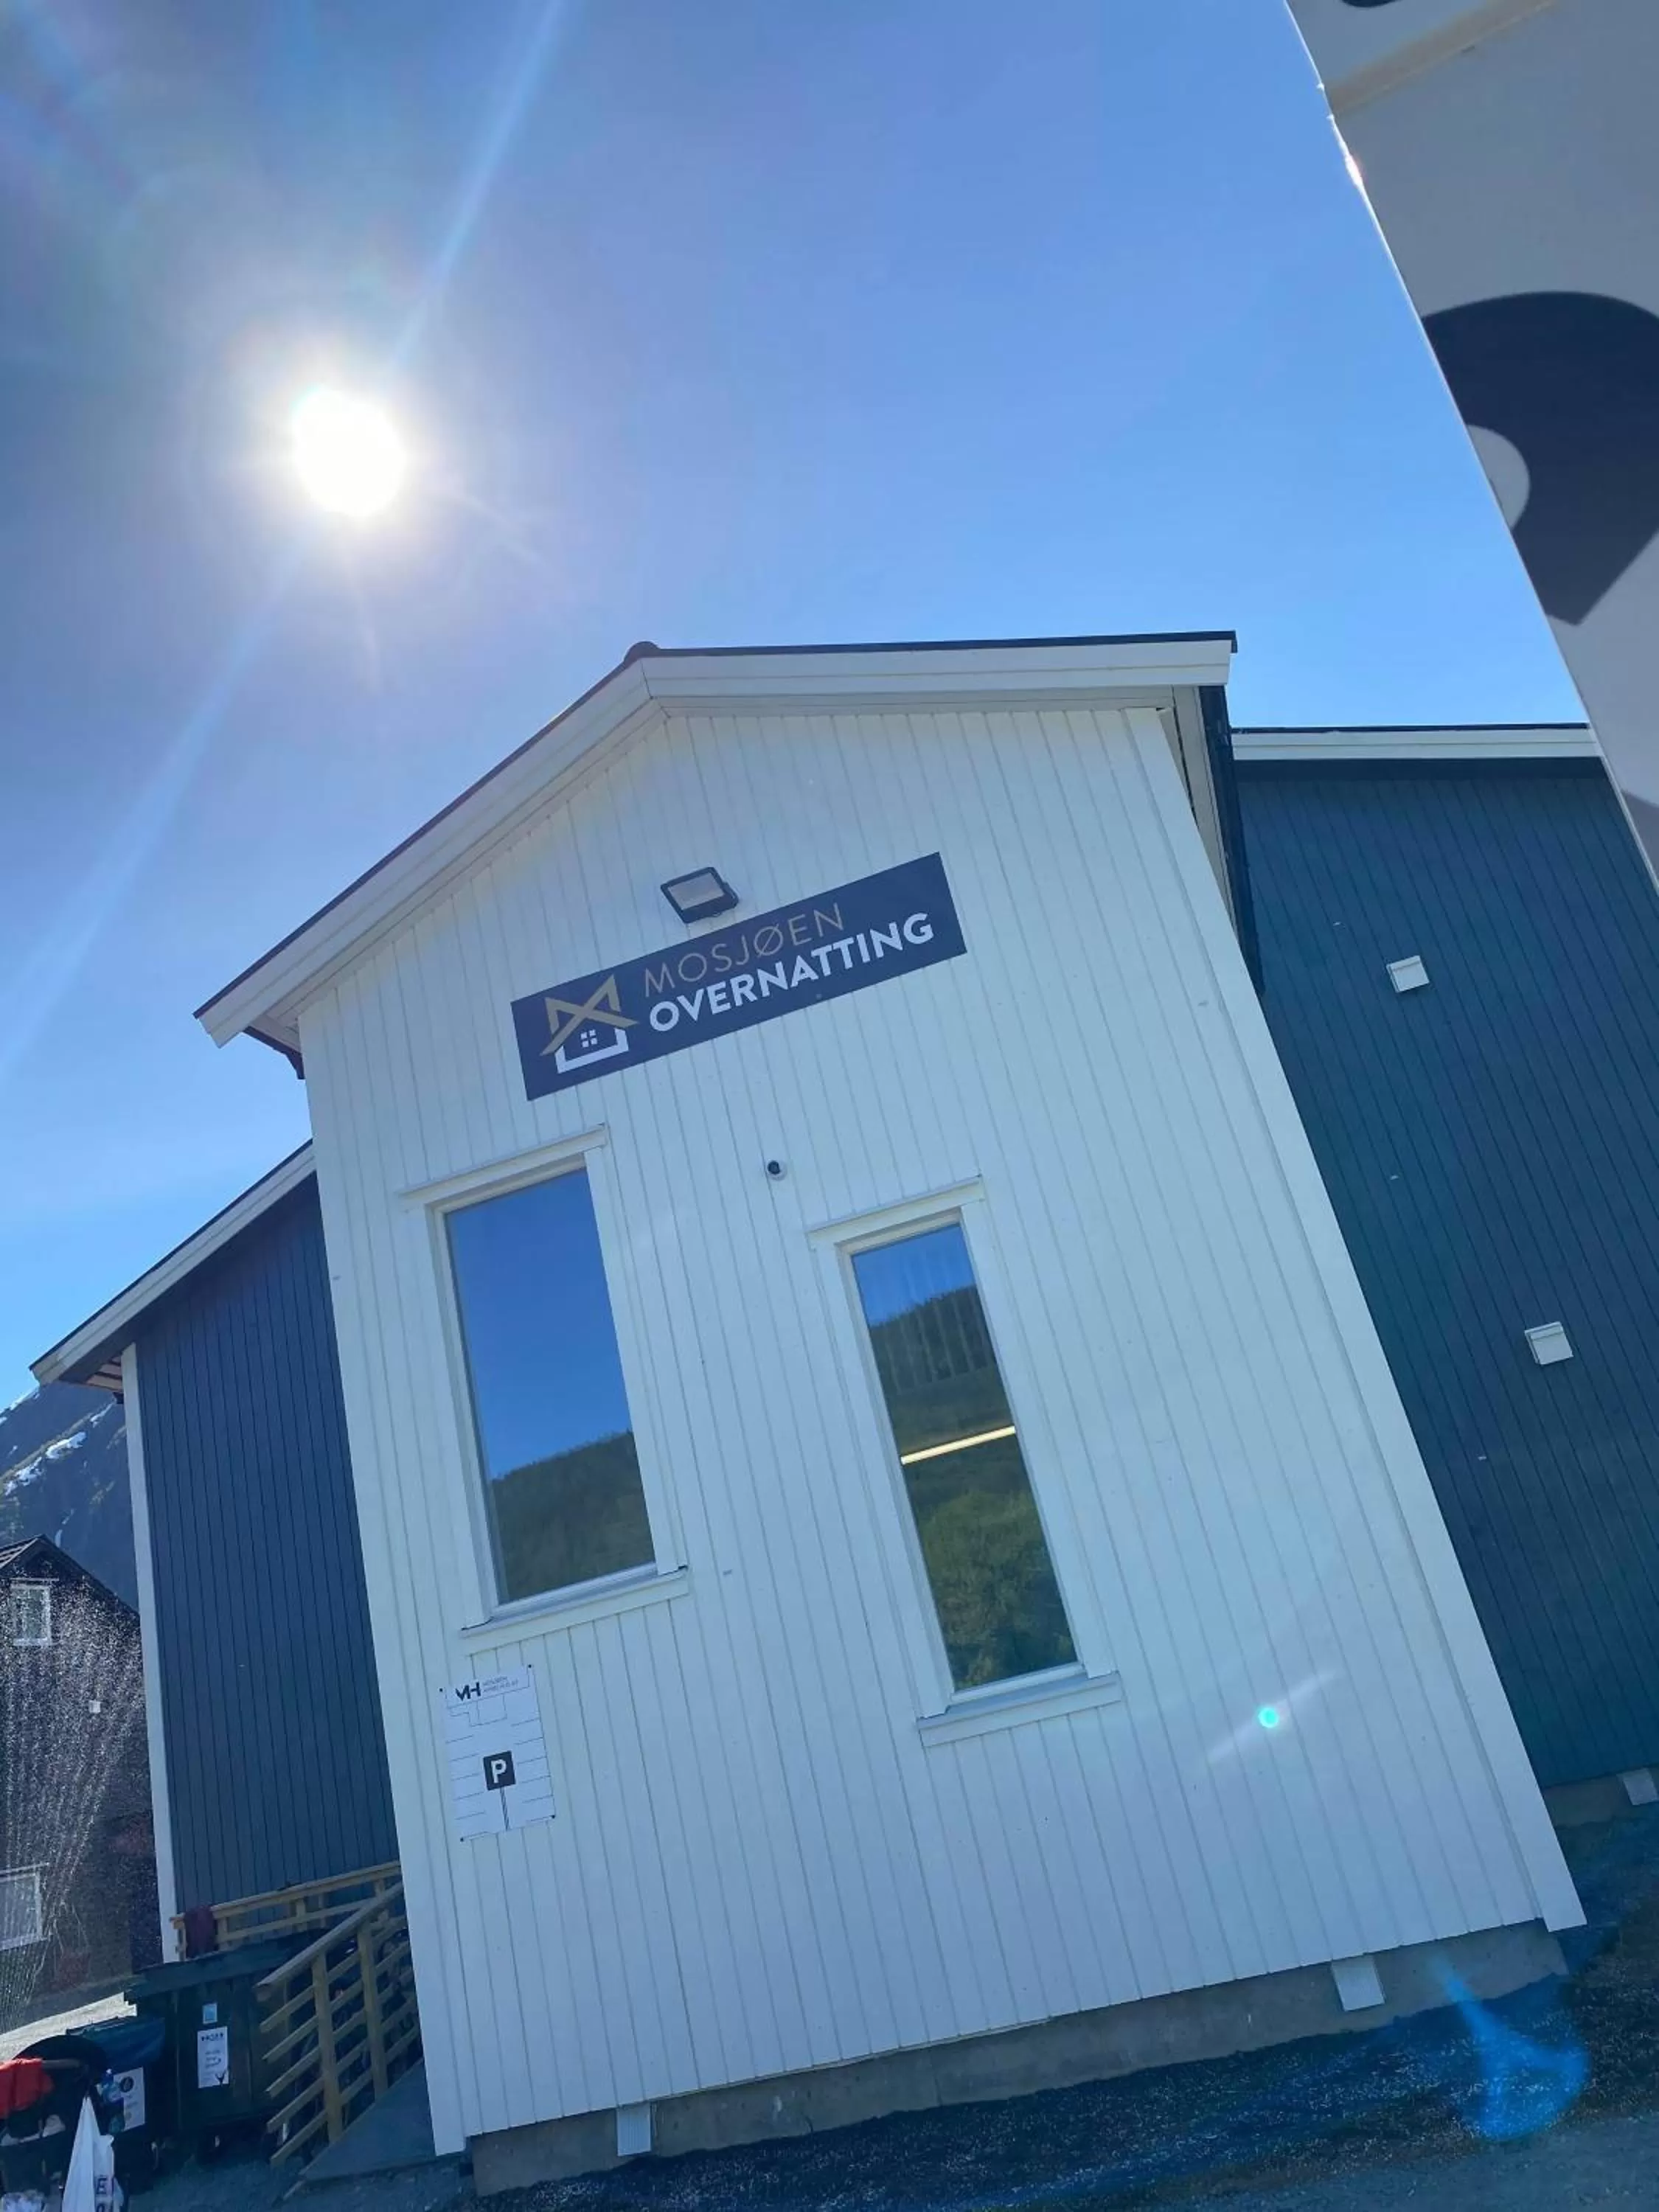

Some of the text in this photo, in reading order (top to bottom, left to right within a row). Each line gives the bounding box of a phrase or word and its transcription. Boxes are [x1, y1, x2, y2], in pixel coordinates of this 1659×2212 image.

[644, 902, 845, 998] MOSJØEN
[649, 912, 934, 1032] OVERNATTING
[490, 1759, 507, 1784] P
